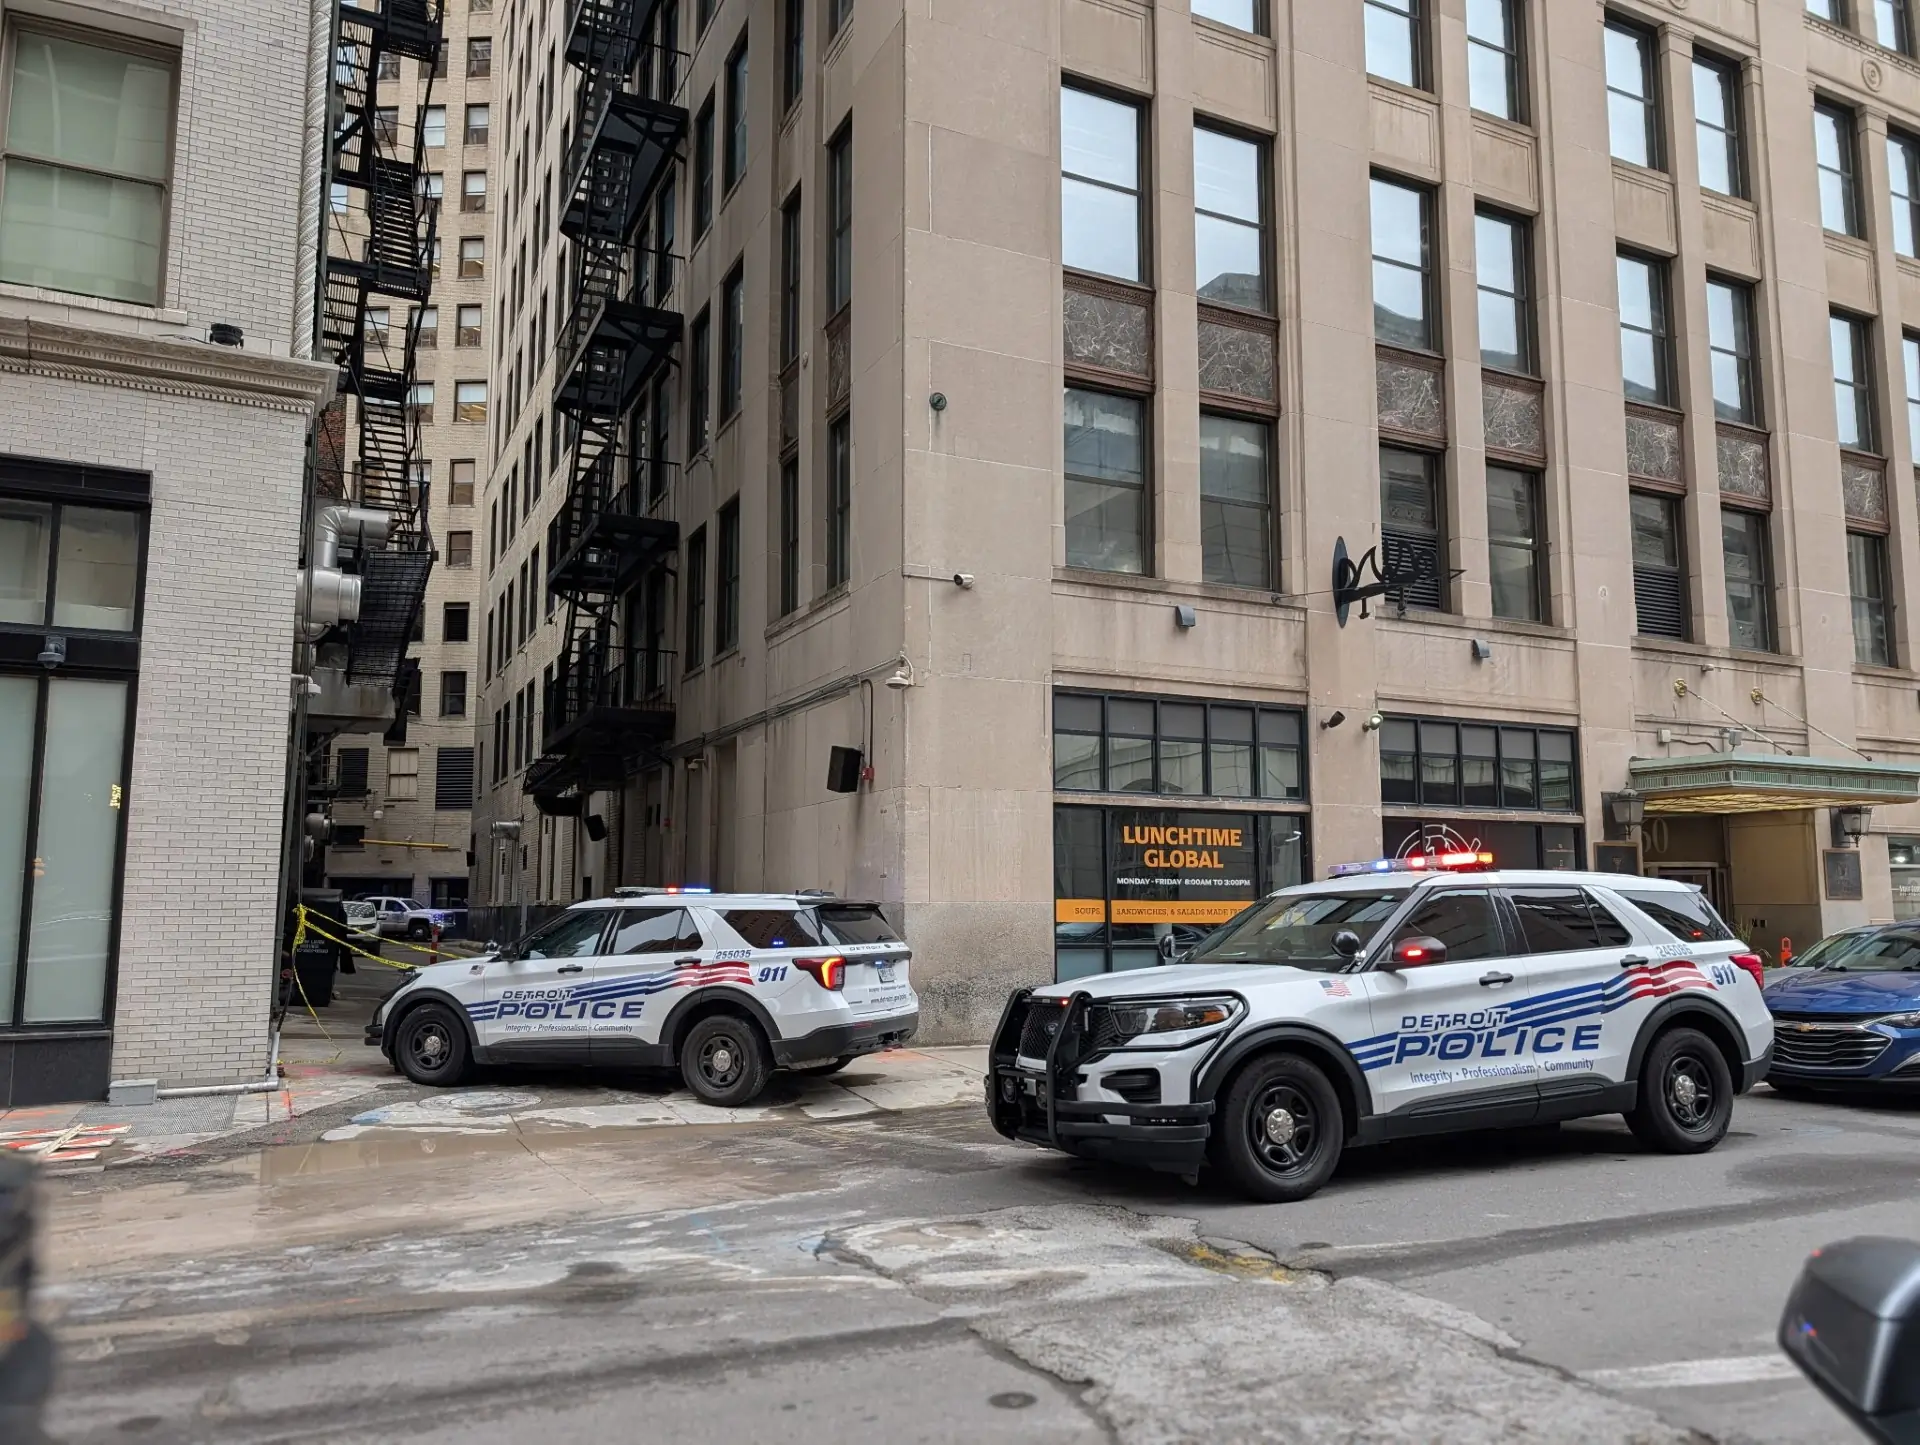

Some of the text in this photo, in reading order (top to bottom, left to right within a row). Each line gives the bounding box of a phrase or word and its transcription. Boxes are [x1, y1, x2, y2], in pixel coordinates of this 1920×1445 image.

[1123, 825, 1243, 847] LUNCHTIME
[1143, 849, 1225, 869] GLOBAL
[1116, 877, 1150, 885] MONDAY
[1155, 878, 1182, 886] FRIDAY
[1223, 879, 1251, 887] 3:00PM
[1116, 908, 1169, 916] SANDWICHES,
[1176, 908, 1205, 916] SALADS
[1206, 908, 1229, 916] MADE
[715, 949, 752, 960] 255035
[1655, 943, 1693, 957] 245086
[758, 966, 788, 983] 911
[1711, 964, 1737, 986] 911
[502, 989, 573, 999] DETROIT
[496, 1001, 645, 1020] POLICE
[1401, 1010, 1508, 1029] DETROIT
[504, 1023, 633, 1033] Integrity Professionalism Community
[1395, 1024, 1603, 1064] POLICE
[1410, 1058, 1594, 1085] Integrity Professionalism Community
